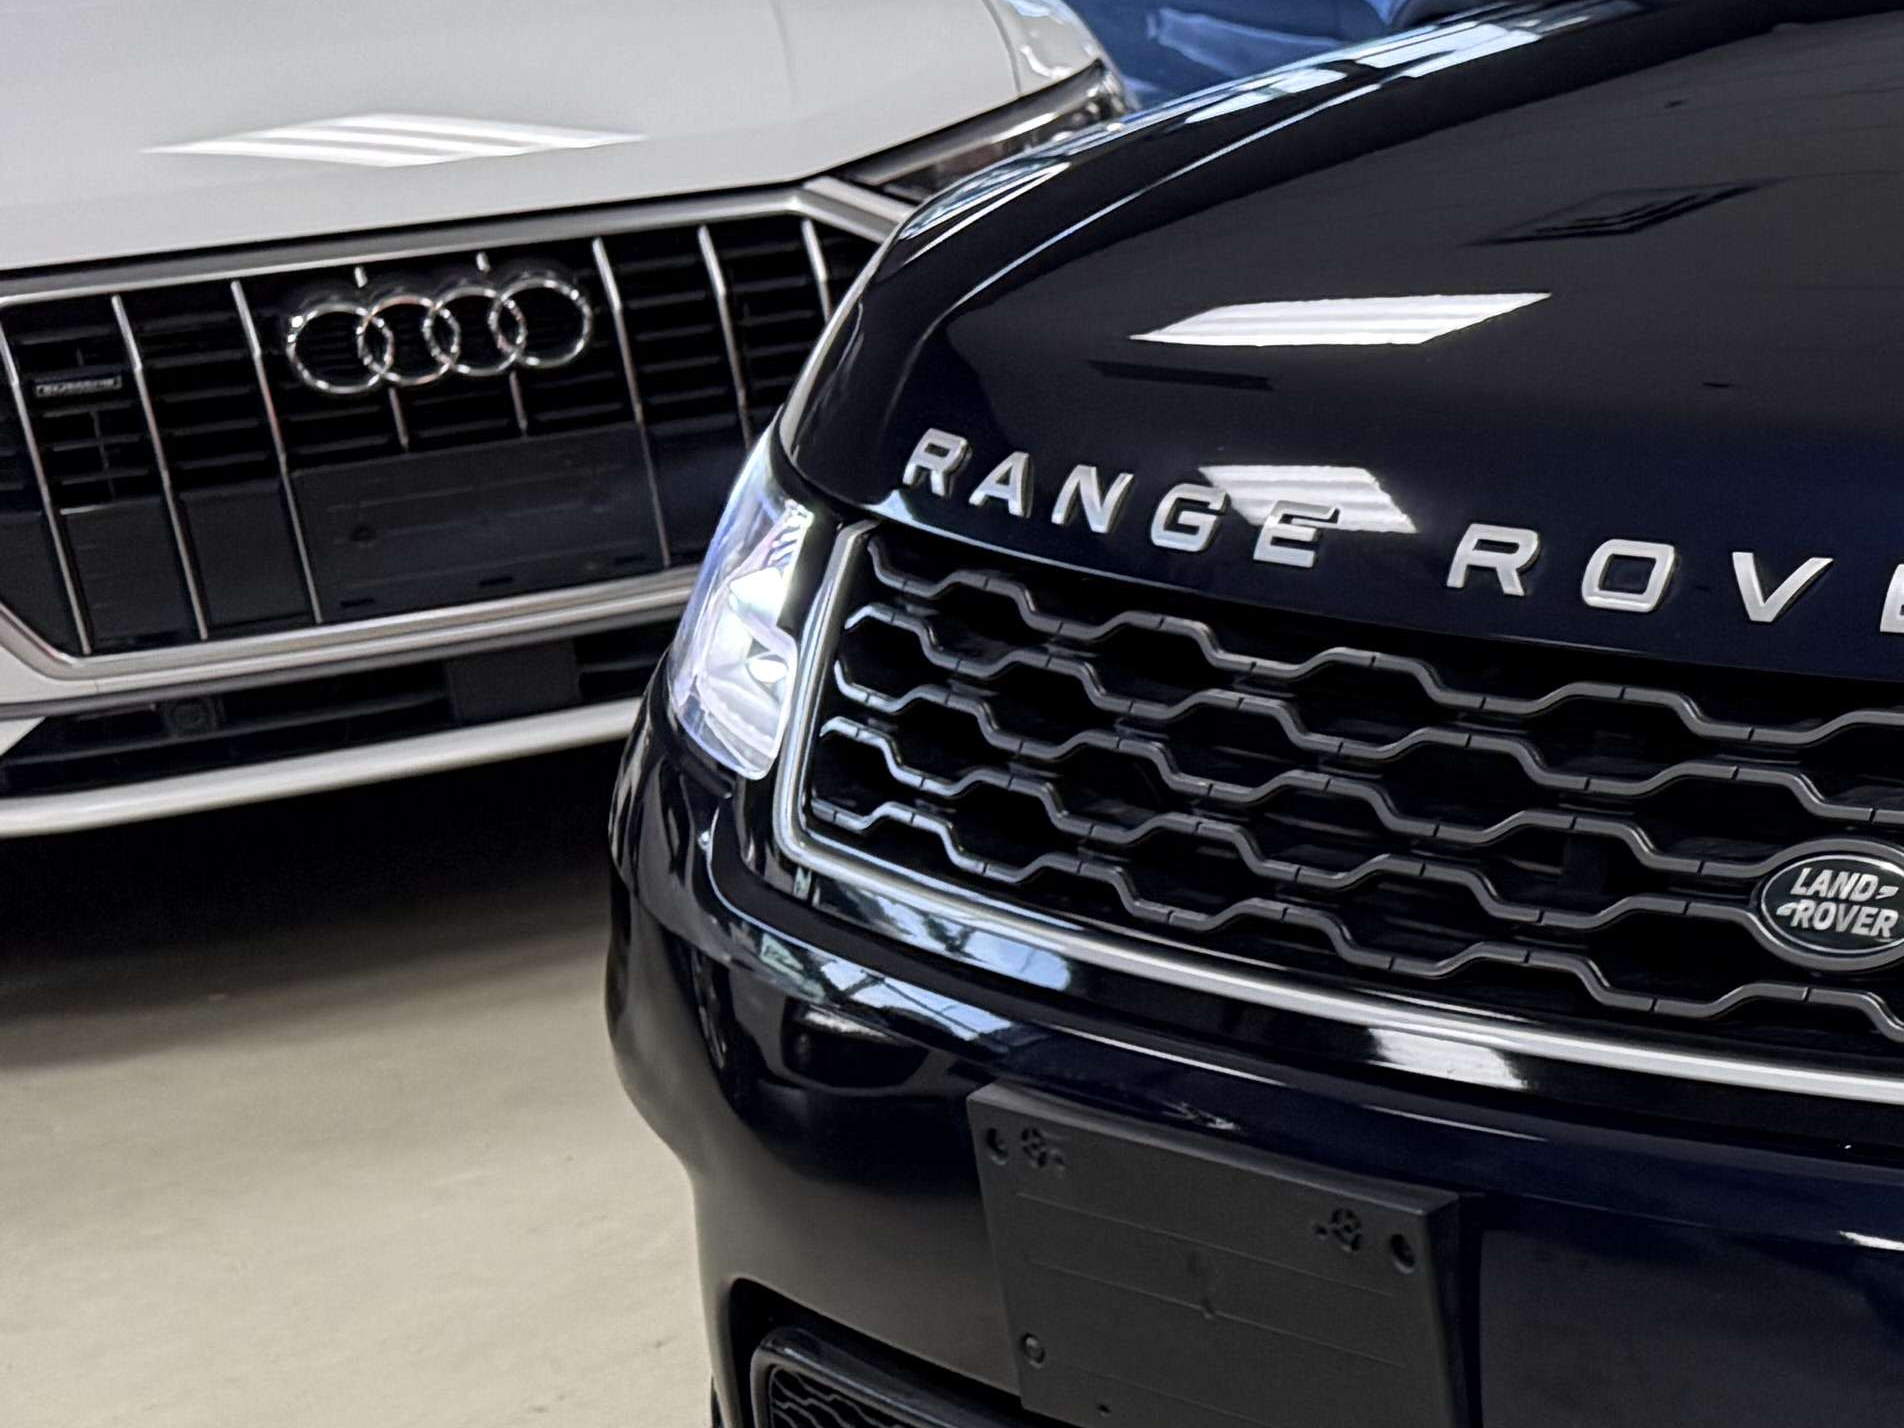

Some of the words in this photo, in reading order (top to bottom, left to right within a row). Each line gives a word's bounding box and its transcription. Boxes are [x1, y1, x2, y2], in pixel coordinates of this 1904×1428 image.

[902, 427, 1341, 569] RANGE
[1789, 866, 1879, 902] LAND
[1789, 898, 1899, 938] ROVER
